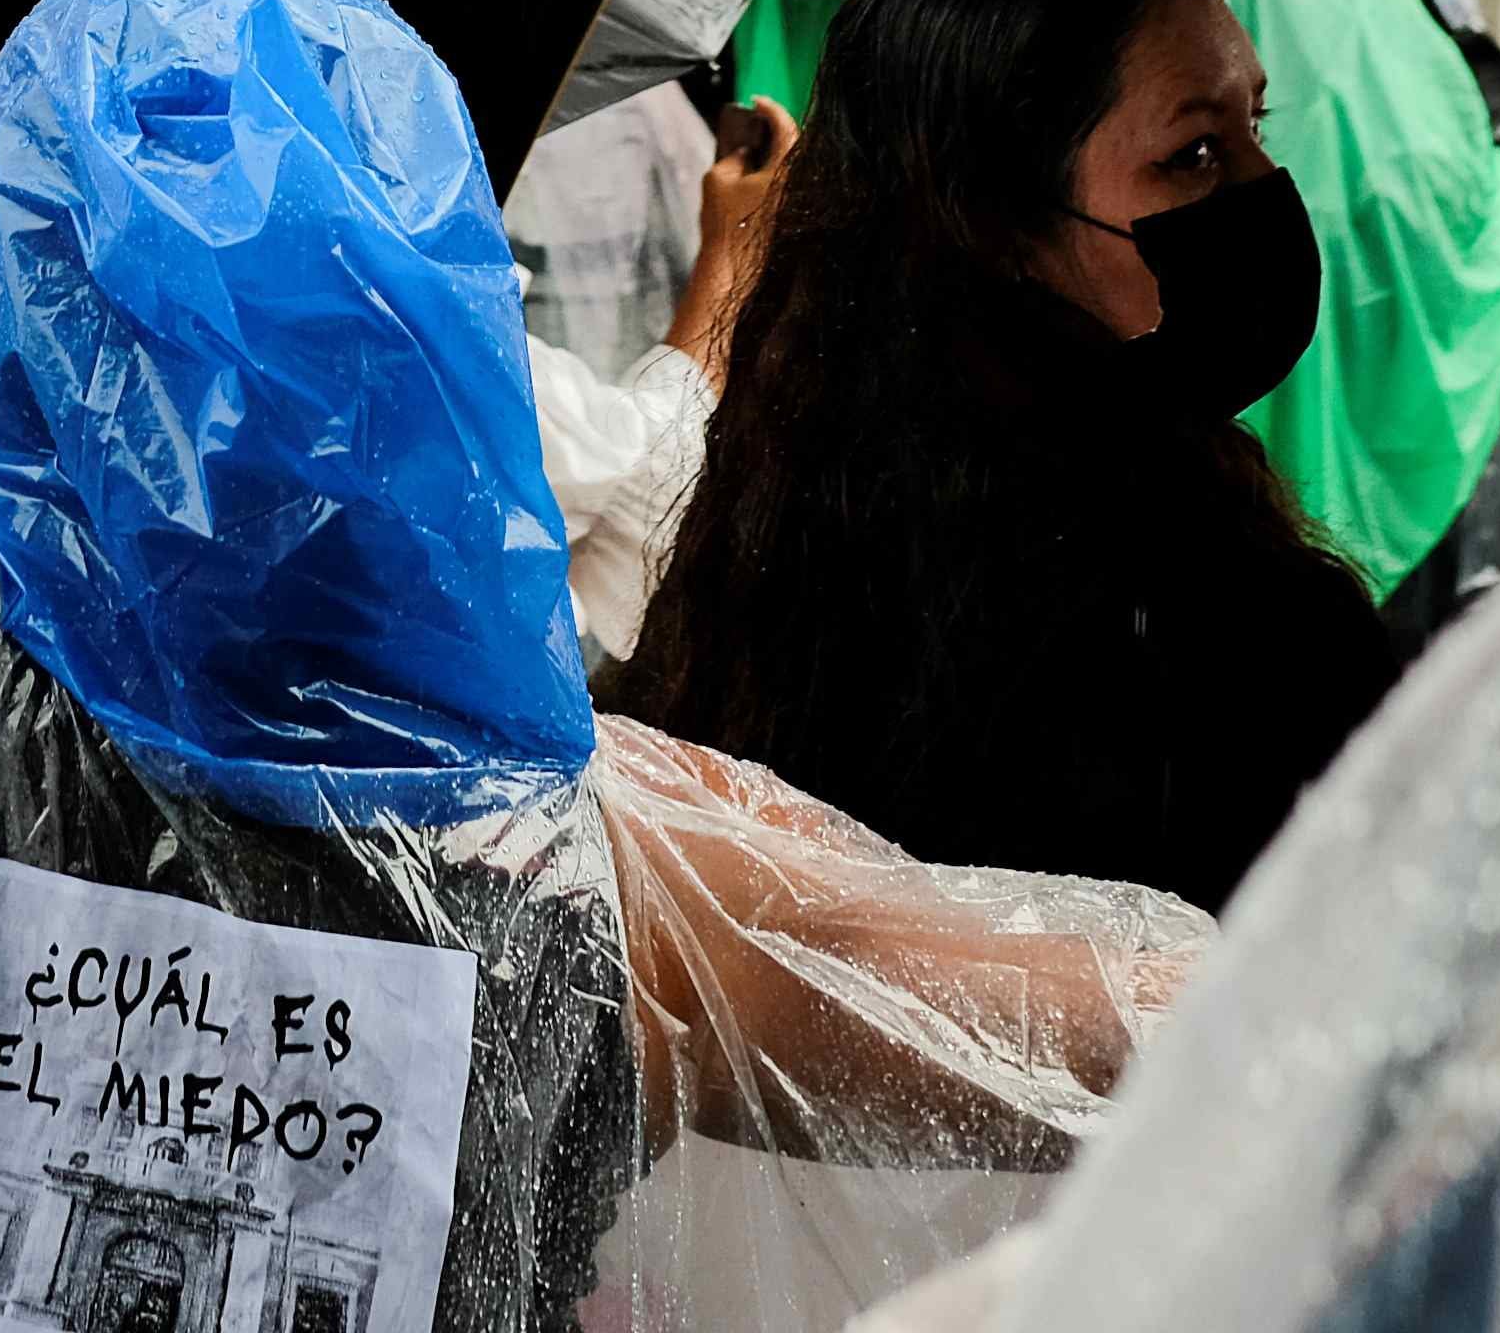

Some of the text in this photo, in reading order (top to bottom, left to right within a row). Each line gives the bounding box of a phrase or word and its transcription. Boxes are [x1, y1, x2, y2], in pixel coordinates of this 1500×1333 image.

[24, 943, 353, 1073] ¿CUÁL ES
[98, 1059, 384, 1174] MIEDO?
